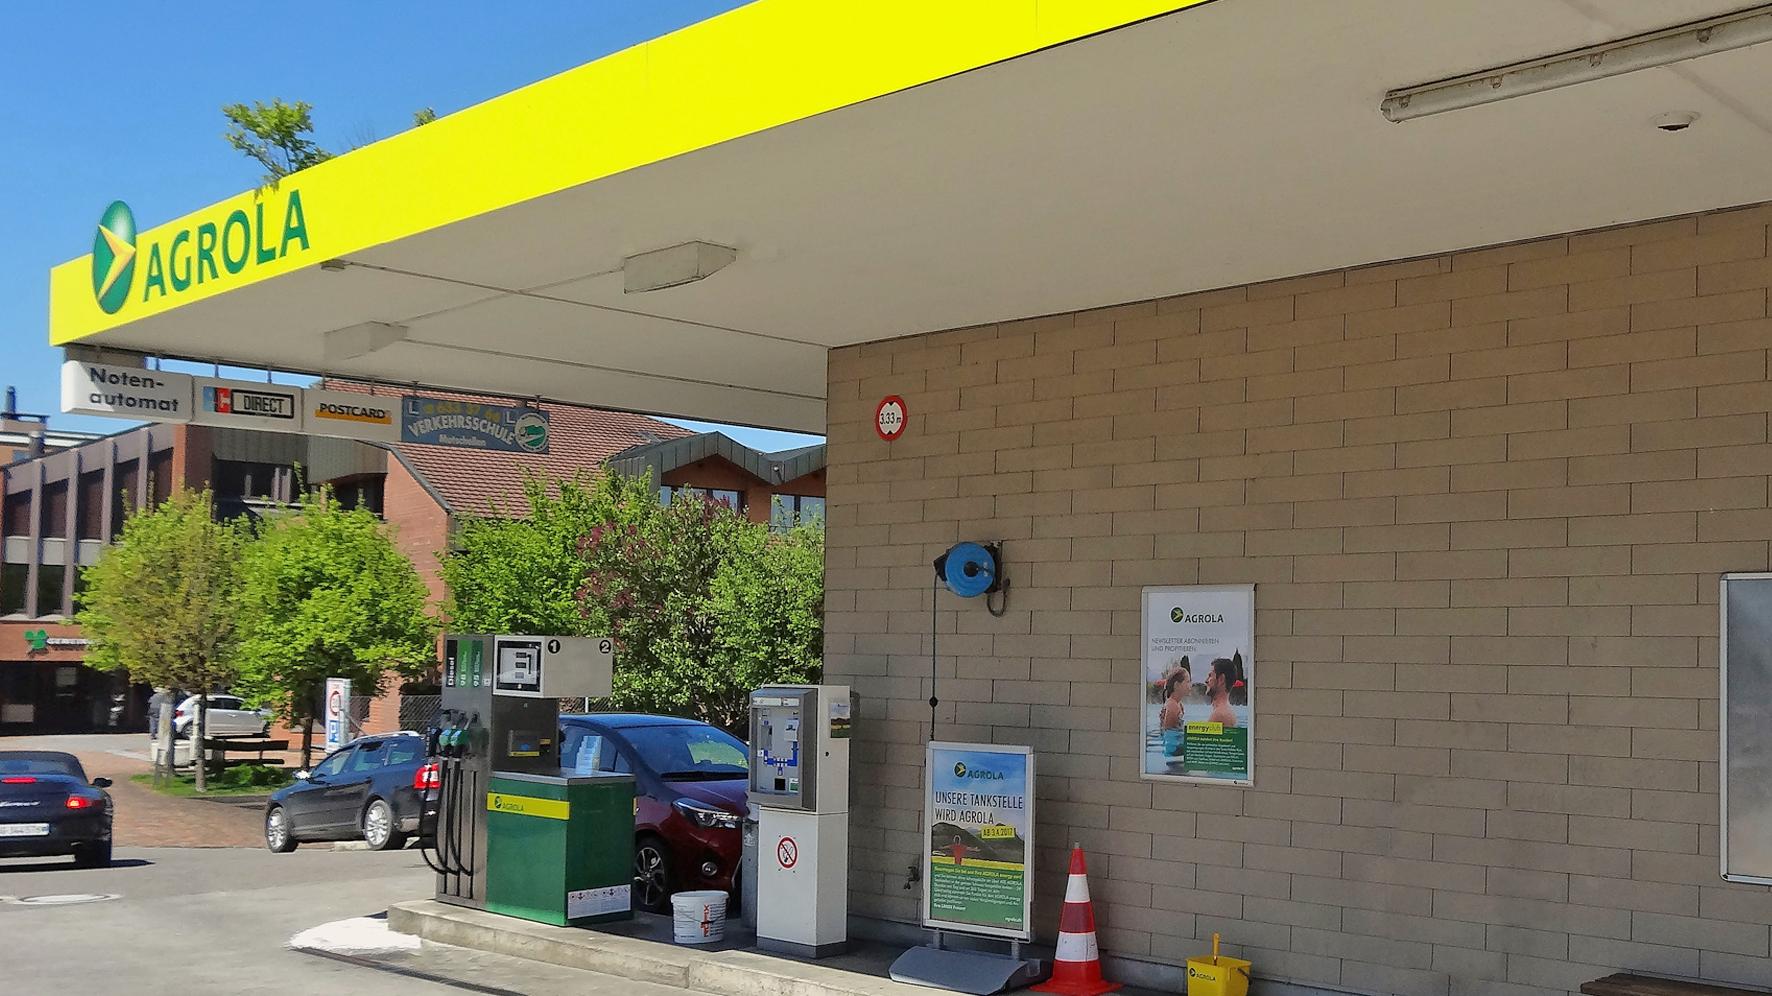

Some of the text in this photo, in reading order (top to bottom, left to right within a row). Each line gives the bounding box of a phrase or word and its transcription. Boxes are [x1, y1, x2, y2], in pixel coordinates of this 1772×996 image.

[142, 189, 311, 303] AGROLA
[90, 367, 164, 389] Noten-
[90, 391, 179, 412] automat
[243, 394, 285, 414] DIRECT
[319, 402, 386, 419] POSTCARD
[879, 412, 895, 425] 3.33
[407, 414, 516, 446] VERKEHRSSCHULE
[1184, 614, 1224, 623] AGROLA
[447, 657, 455, 686] Diesel
[967, 770, 1004, 780] AGROLA
[935, 791, 1023, 809] UNSERE TANKSTELLE
[935, 808, 994, 824] WIRD AGROLA
